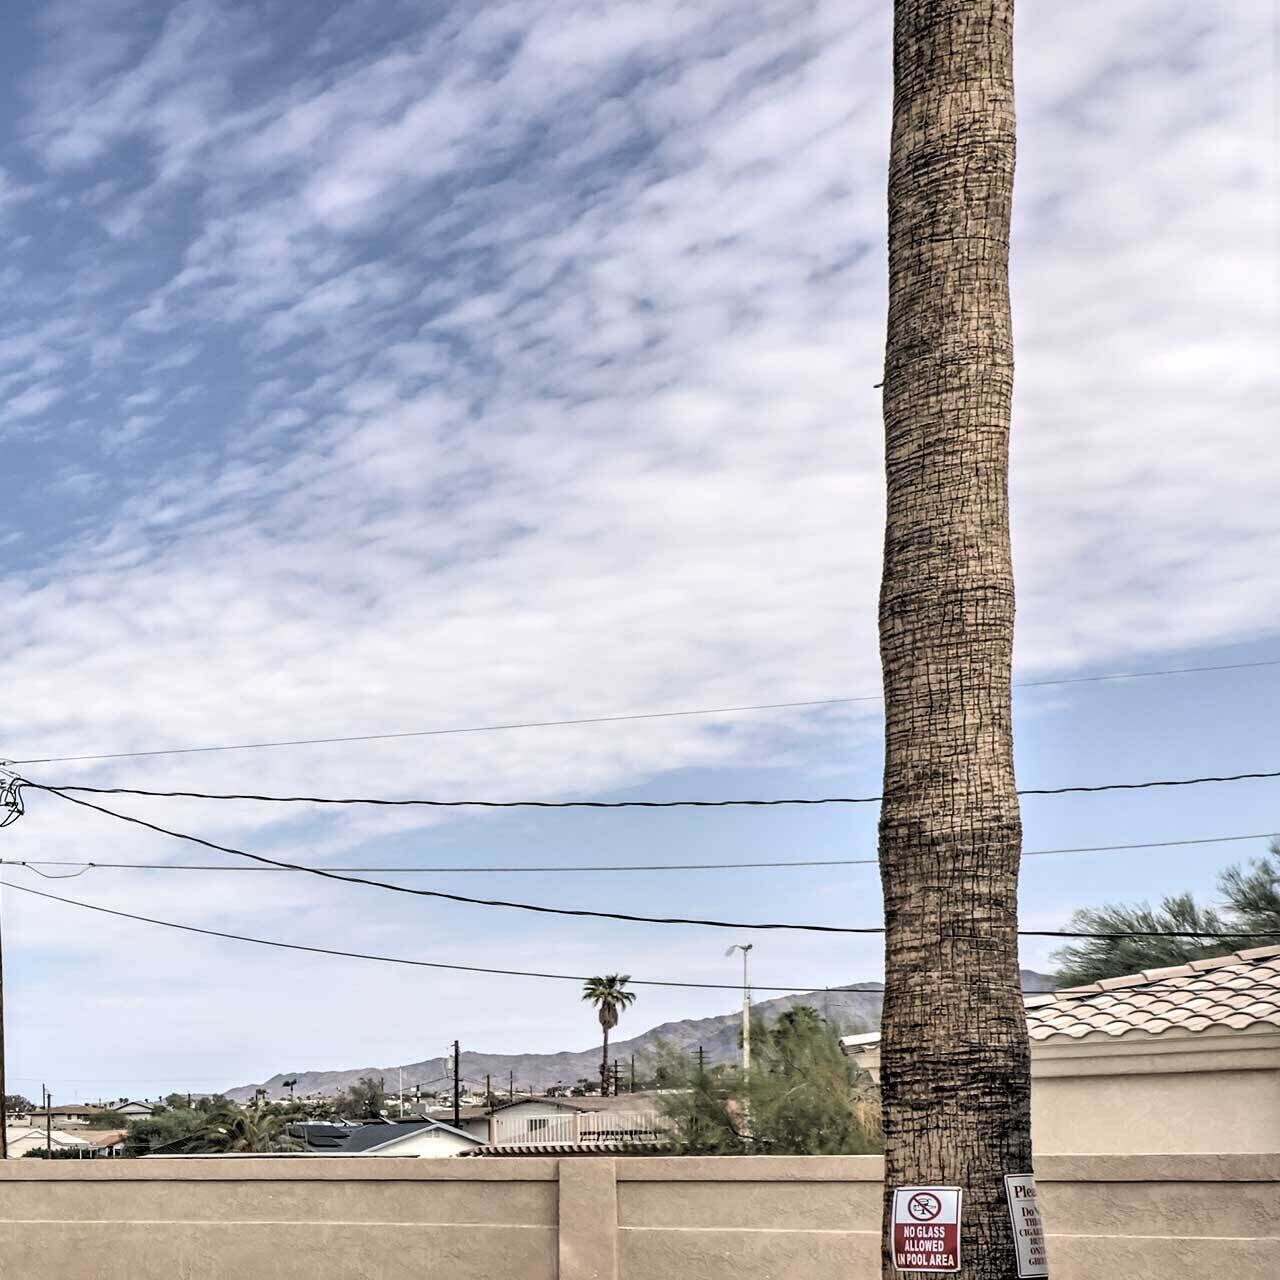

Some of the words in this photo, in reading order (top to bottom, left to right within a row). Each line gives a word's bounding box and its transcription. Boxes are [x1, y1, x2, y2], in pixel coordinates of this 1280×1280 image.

[1021, 1207, 1034, 1217] Do
[903, 1226, 915, 1238] NO
[917, 1226, 945, 1238] GLASS
[904, 1240, 944, 1252] ALLOWED
[897, 1253, 906, 1265] IN
[907, 1253, 928, 1265] POOL
[930, 1254, 955, 1266] AREA
